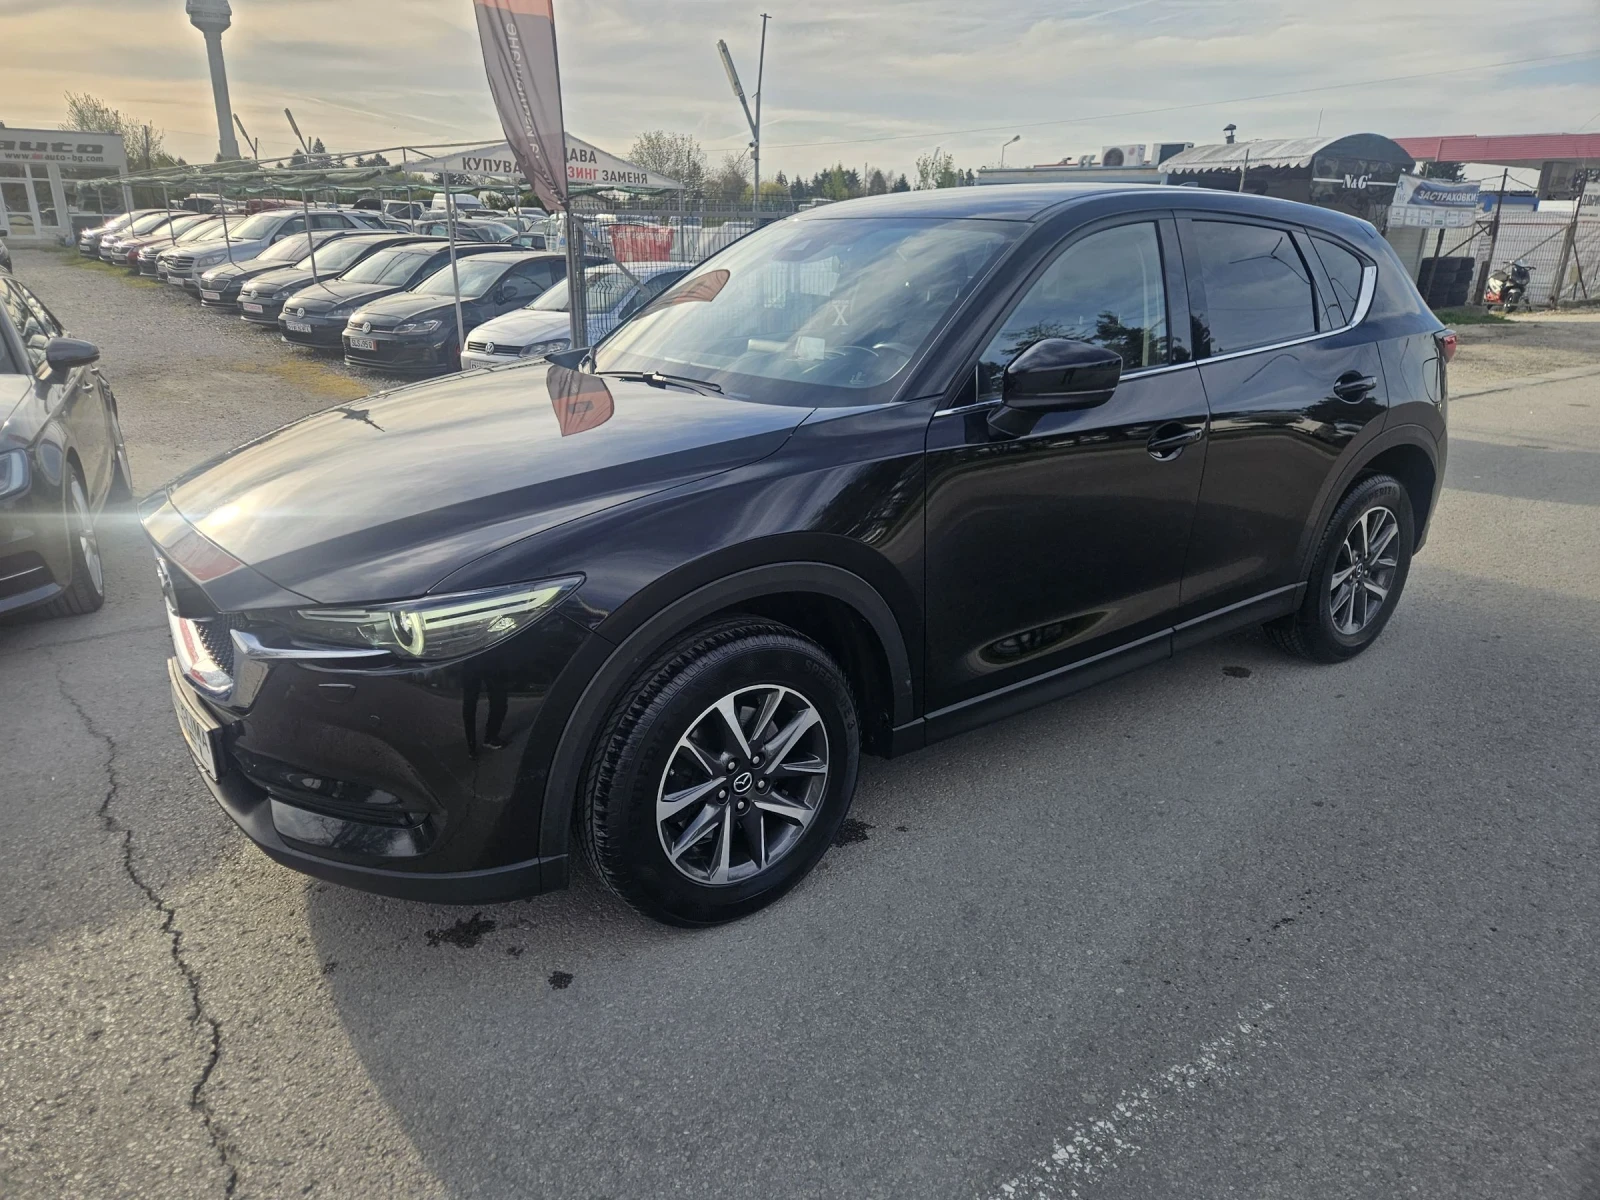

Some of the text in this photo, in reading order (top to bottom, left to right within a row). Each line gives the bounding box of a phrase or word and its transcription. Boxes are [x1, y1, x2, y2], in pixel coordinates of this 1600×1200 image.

[462, 147, 598, 174] КУПУВА АВА
[568, 166, 648, 184] ЗИНГ ЗАМЕНЯ
[1418, 190, 1477, 203] ЗАСТРАХОВКИ
